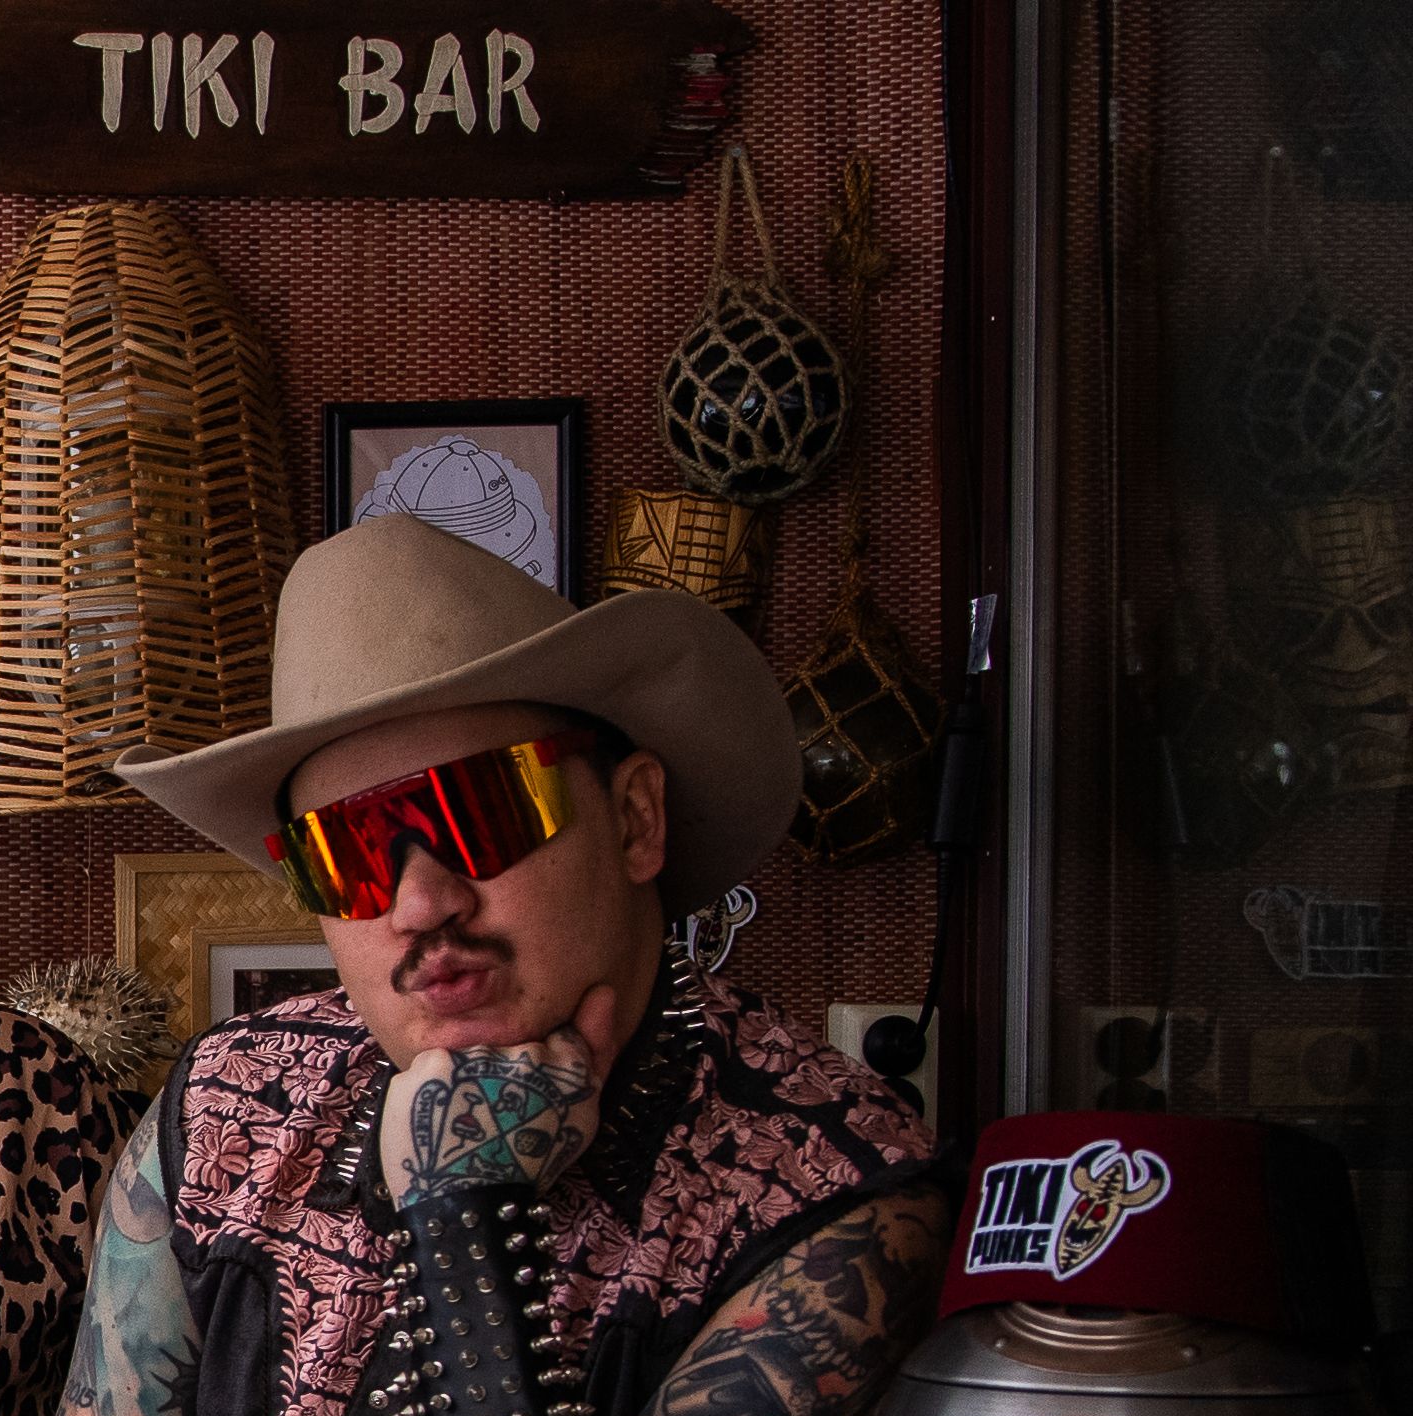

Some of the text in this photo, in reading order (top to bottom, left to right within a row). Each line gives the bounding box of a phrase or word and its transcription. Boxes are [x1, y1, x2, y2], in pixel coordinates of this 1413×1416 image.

[73, 28, 541, 139] TIKI BAR
[978, 1163, 1068, 1228] TIKI
[969, 1227, 1053, 1269] PUNKS
